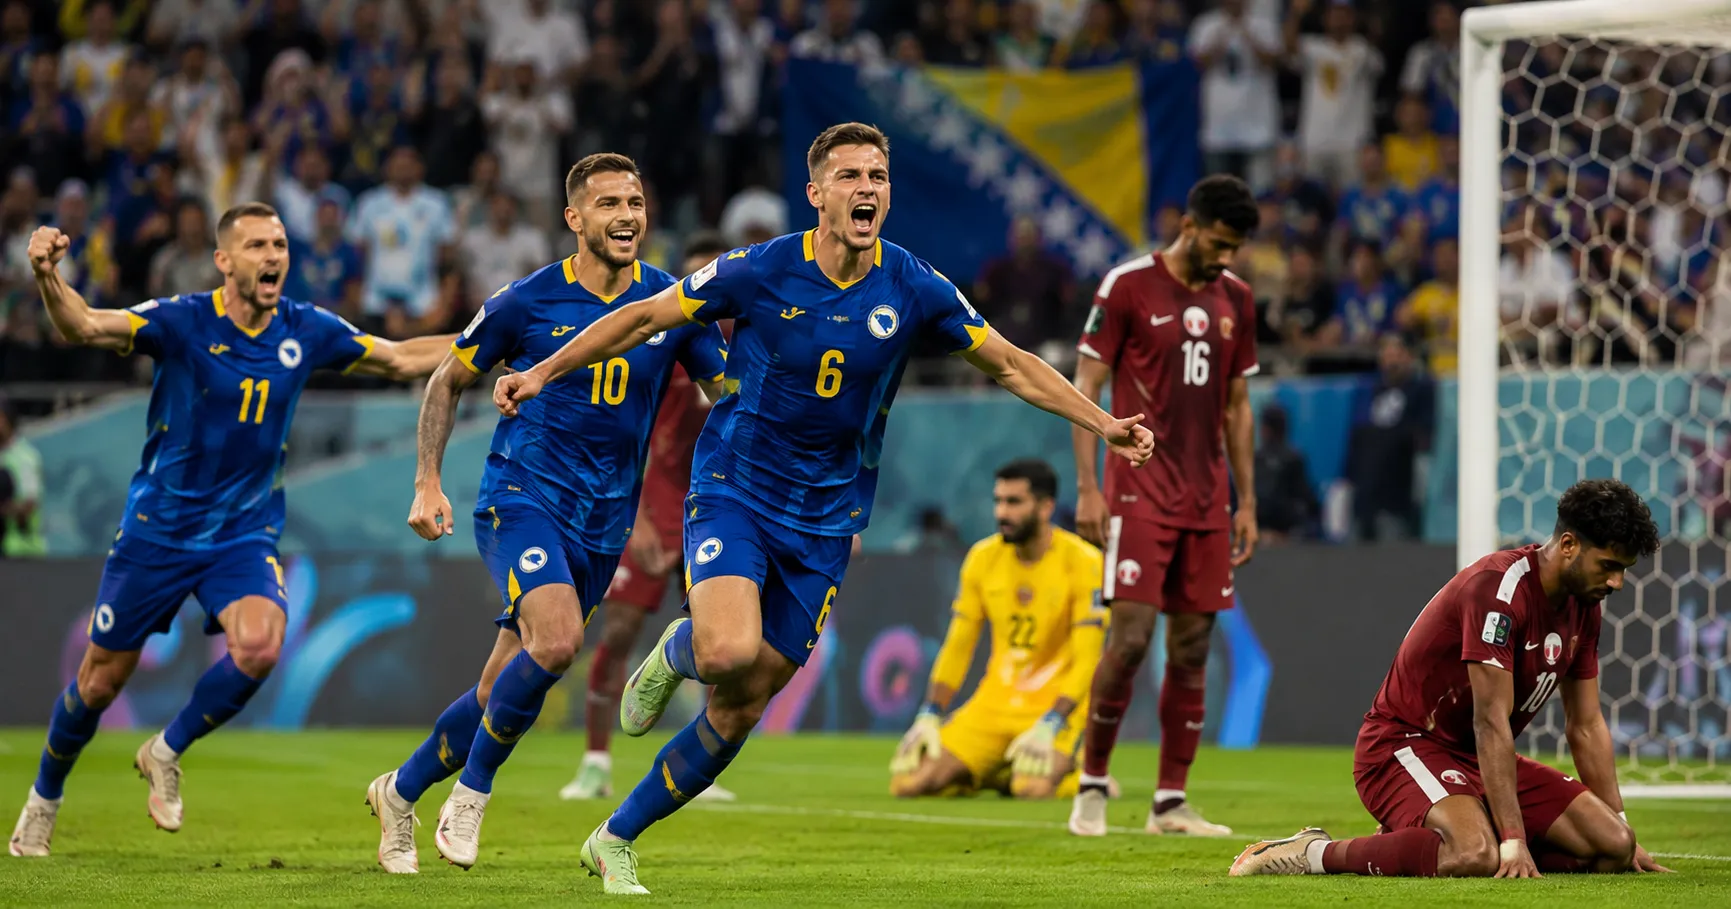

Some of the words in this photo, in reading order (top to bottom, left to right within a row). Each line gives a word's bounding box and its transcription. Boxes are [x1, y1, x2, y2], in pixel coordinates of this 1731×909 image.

[587, 357, 630, 406] 10
[815, 349, 845, 398] 6
[1181, 340, 1211, 386] 16
[239, 377, 270, 424] 11
[815, 585, 837, 635] 6
[1009, 614, 1036, 649] 22
[1519, 671, 1557, 713] 10
